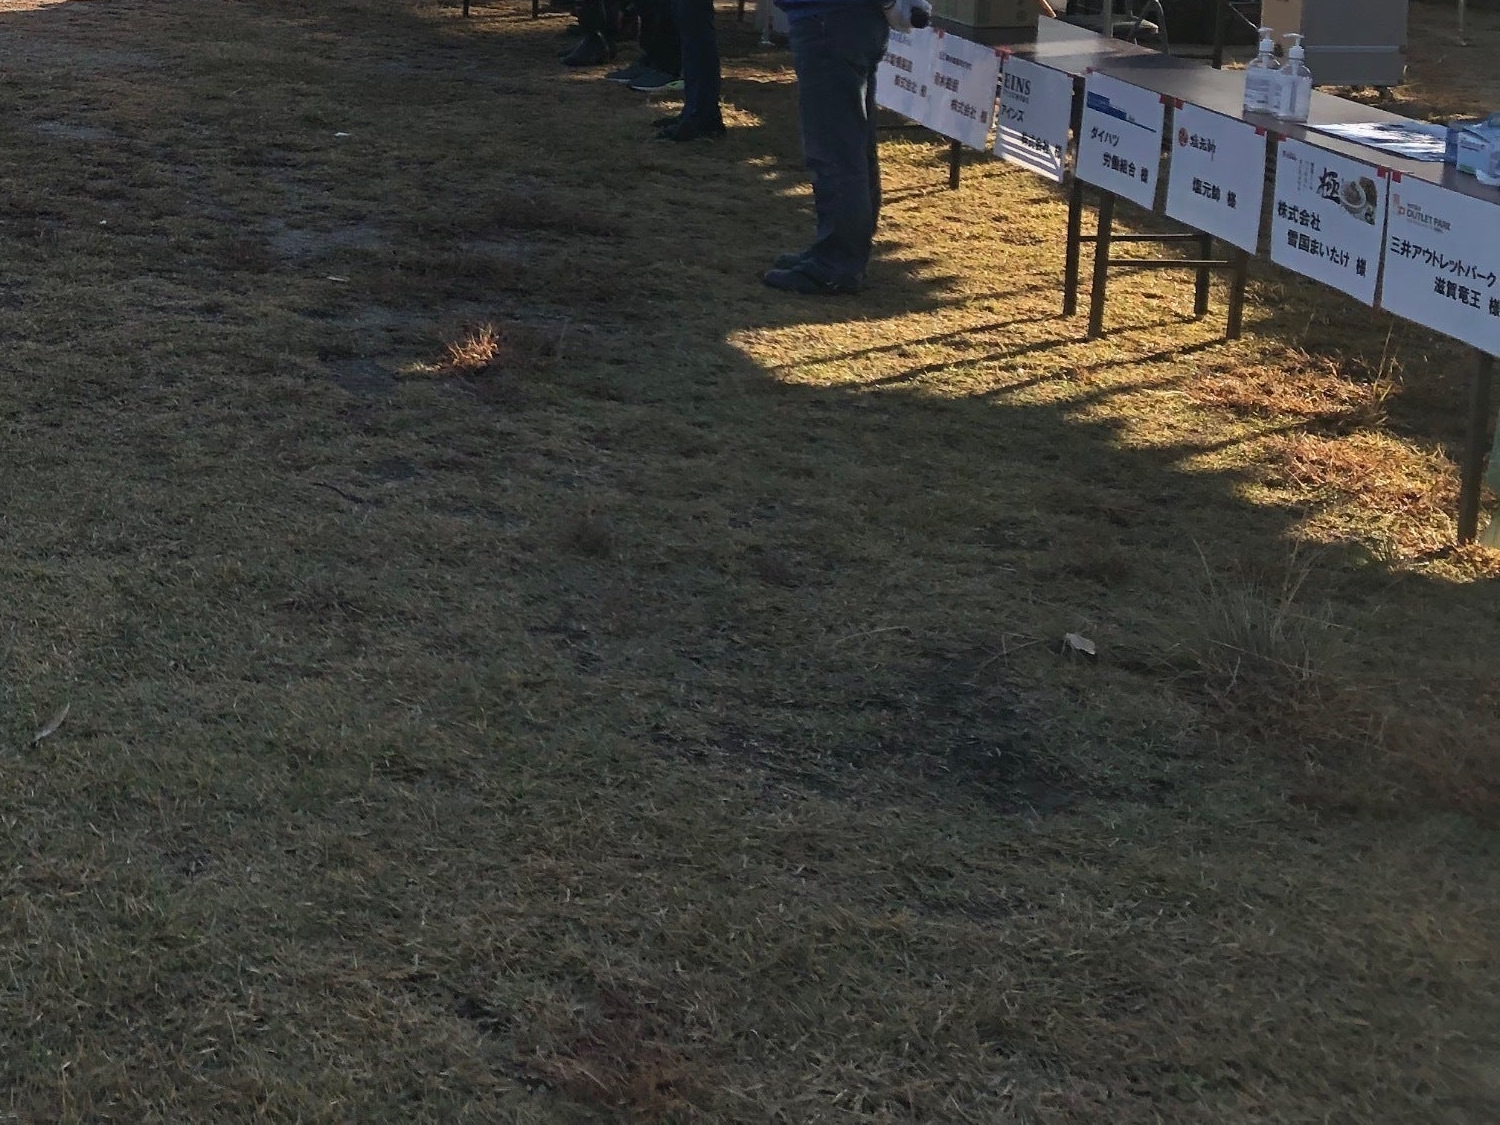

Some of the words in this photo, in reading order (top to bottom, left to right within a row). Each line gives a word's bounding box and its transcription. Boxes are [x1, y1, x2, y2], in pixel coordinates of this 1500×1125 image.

[1090, 126, 1120, 147] ダイハツ
[1102, 152, 1137, 178] 労働組合
[1278, 199, 1321, 232] 株式会社
[1287, 229, 1350, 267] 雪国まいたけ
[1390, 236, 1497, 288] 三井アウトレットパーク
[1434, 276, 1481, 309] 滋賀竜王
